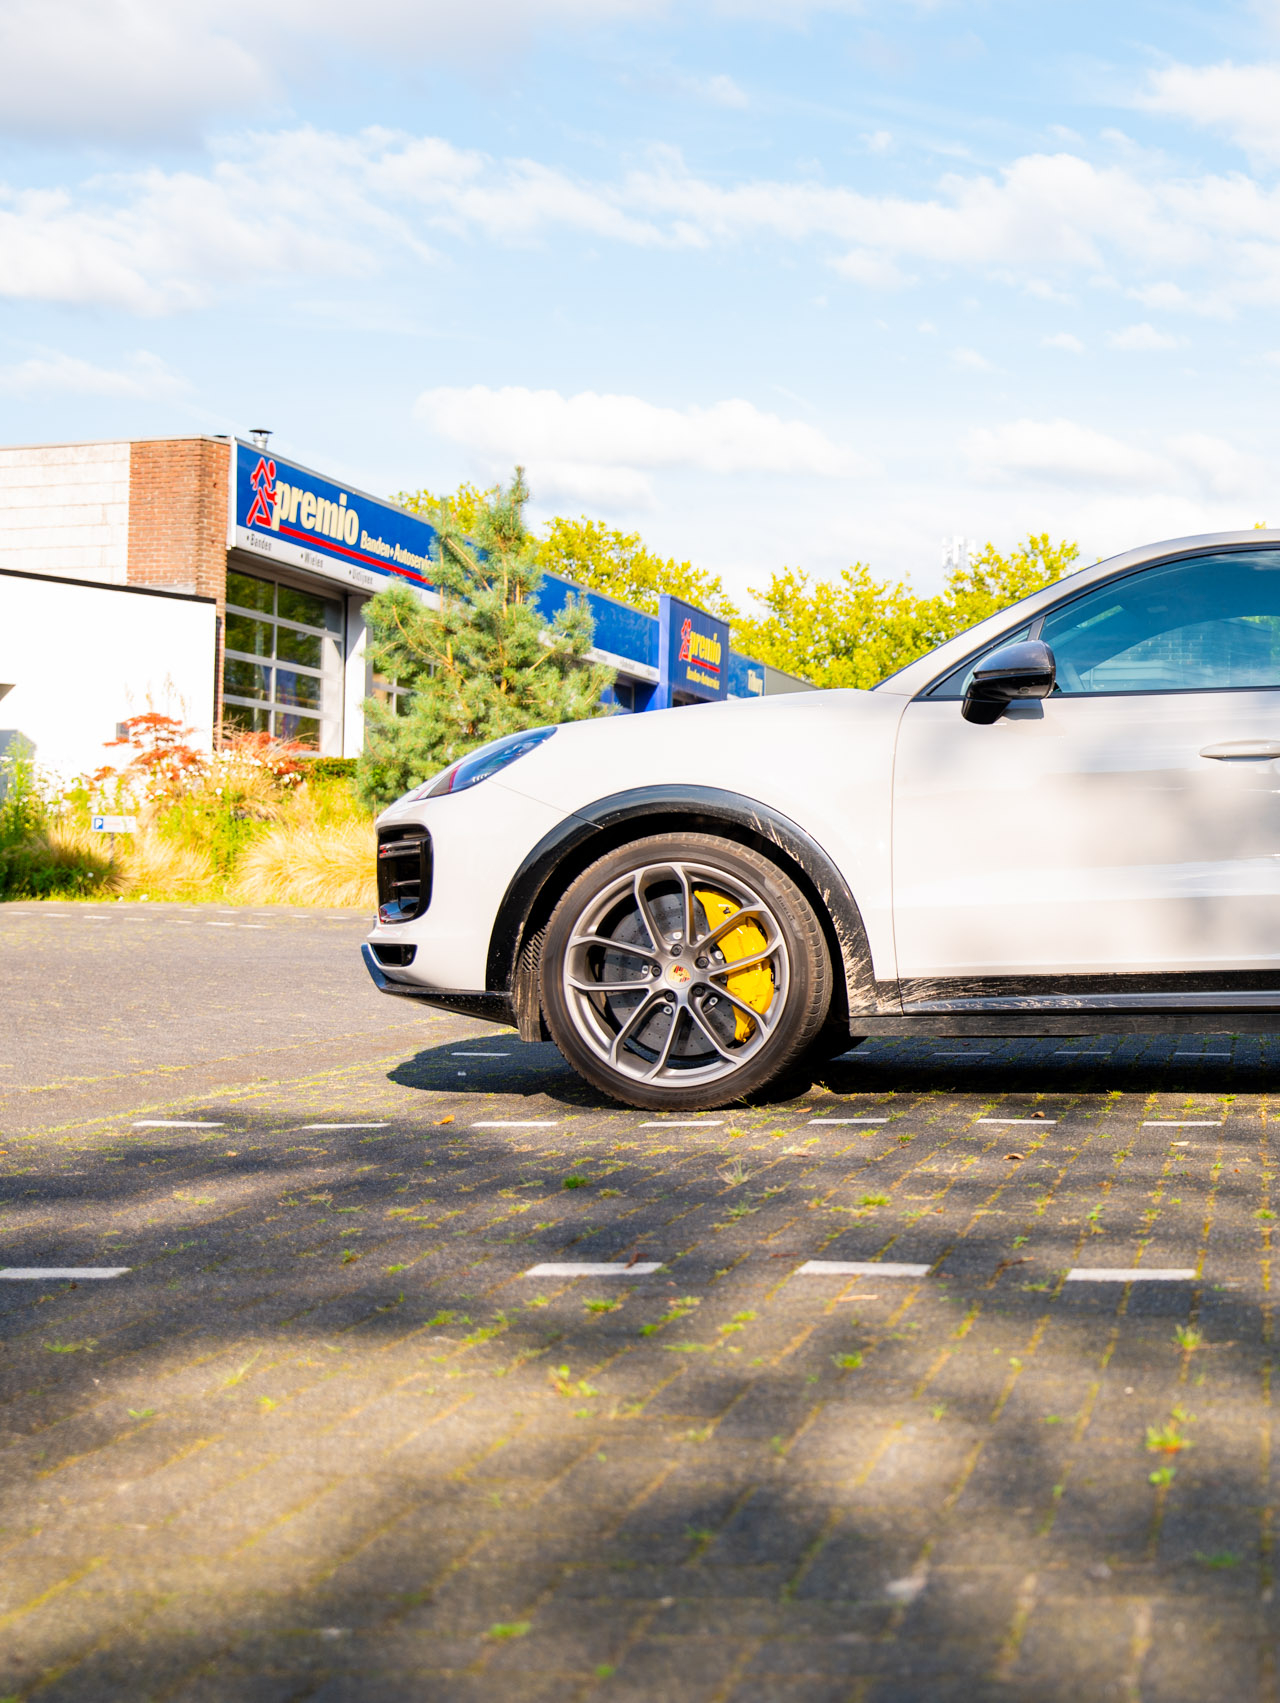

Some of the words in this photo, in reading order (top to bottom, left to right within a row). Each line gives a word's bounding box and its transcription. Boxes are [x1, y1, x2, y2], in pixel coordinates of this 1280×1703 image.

[271, 480, 360, 546] premio
[250, 533, 272, 552] Banden
[688, 631, 721, 666] premio
